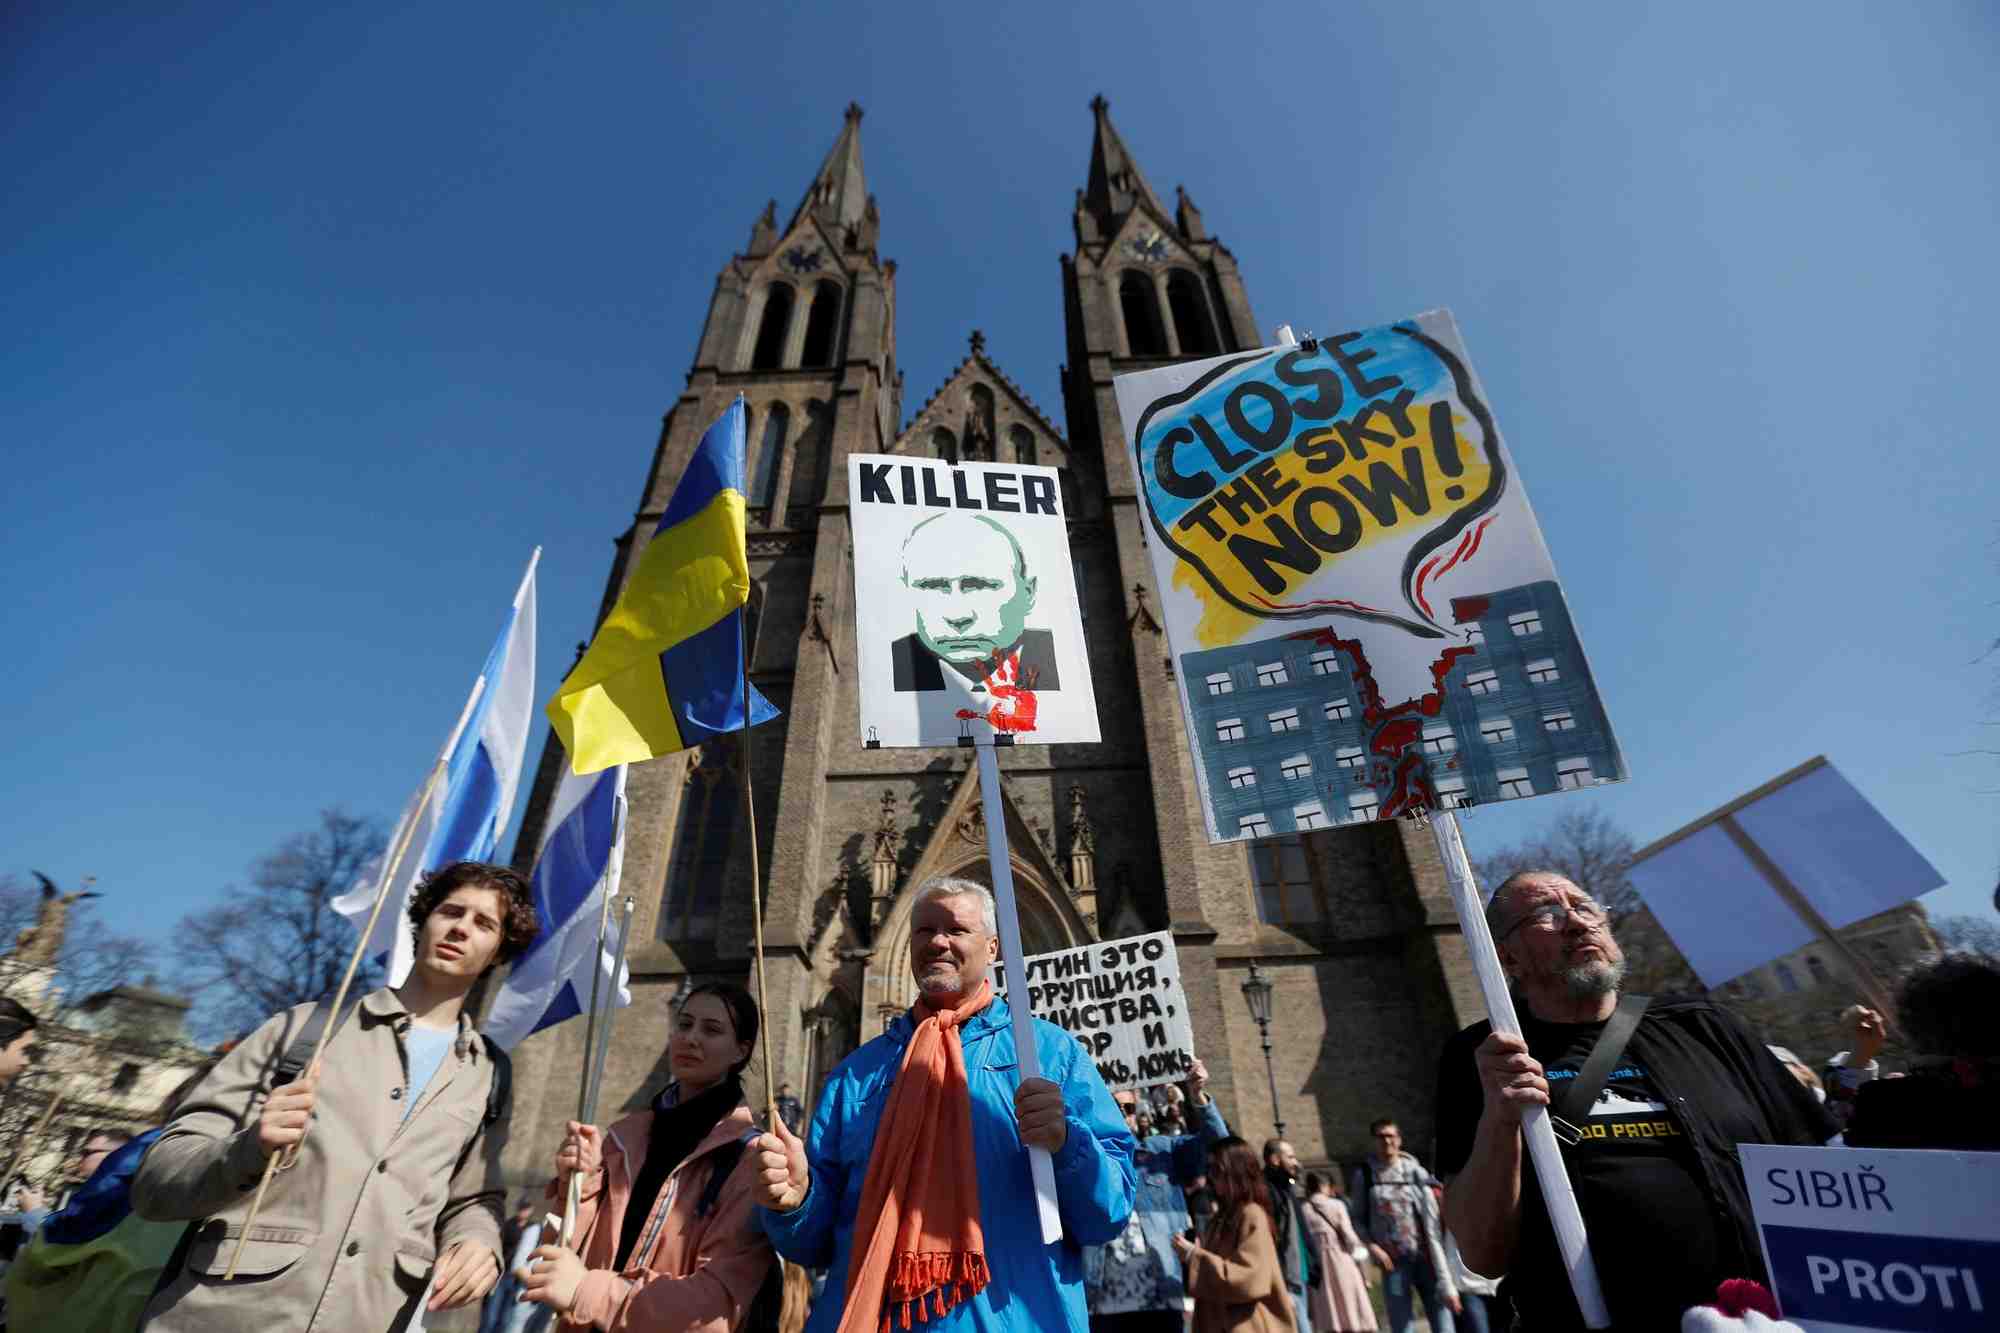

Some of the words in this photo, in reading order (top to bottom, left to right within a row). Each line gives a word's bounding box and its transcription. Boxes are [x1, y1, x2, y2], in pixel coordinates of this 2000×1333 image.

[1154, 332, 1403, 499] CLOSE
[859, 463, 1058, 515] KILLER
[1178, 457, 1300, 542] THE
[1294, 388, 1416, 474] SKY
[1227, 400, 1465, 595] NOW!
[1101, 938, 1164, 969] ЭТО
[1026, 966, 1171, 1010] РРУПЦИЯ,
[1143, 1021, 1168, 1048] И
[1767, 1164, 1894, 1212] SIBIŘ
[1806, 1255, 1984, 1312] PROTI
